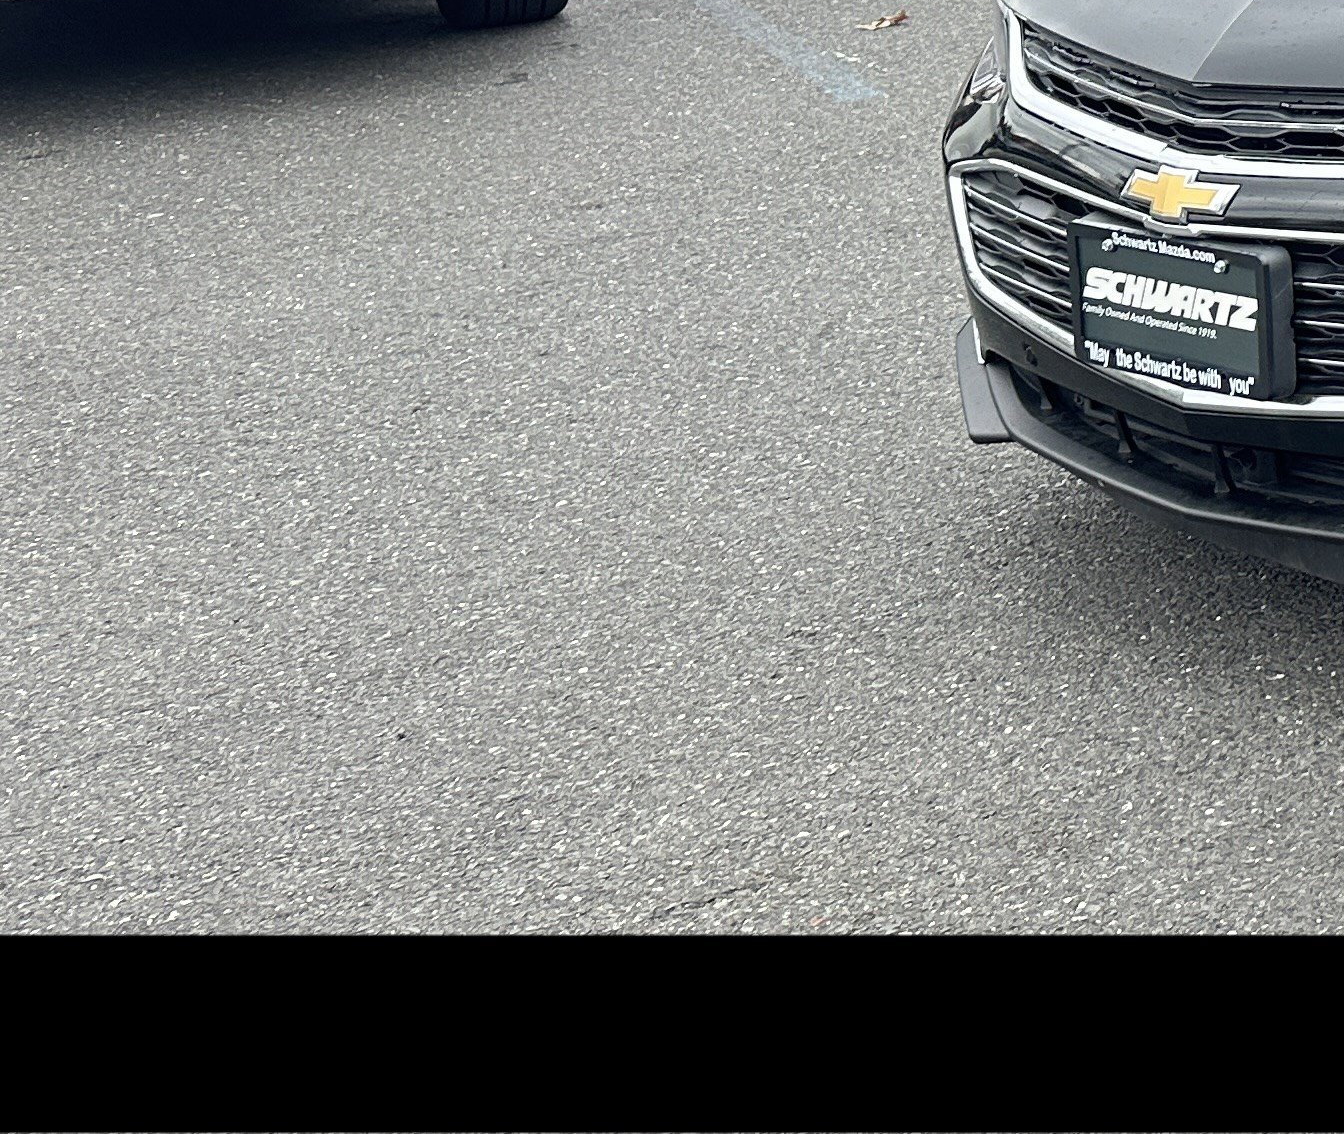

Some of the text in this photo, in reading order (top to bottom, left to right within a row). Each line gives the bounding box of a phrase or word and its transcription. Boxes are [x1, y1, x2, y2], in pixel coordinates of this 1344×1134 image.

[1112, 231, 1215, 264] Schwartz Mazda.com
[1083, 266, 1259, 332] SCHWARTZ
[1081, 302, 1106, 318] Family
[1105, 306, 1131, 321] Owned
[1131, 311, 1145, 323] And
[1145, 315, 1178, 333] Operated
[1178, 321, 1197, 336] Since
[1116, 350, 1133, 369] the
[1134, 352, 1182, 381] Schwartz
[1182, 362, 1197, 384] be
[1198, 369, 1221, 389] with
